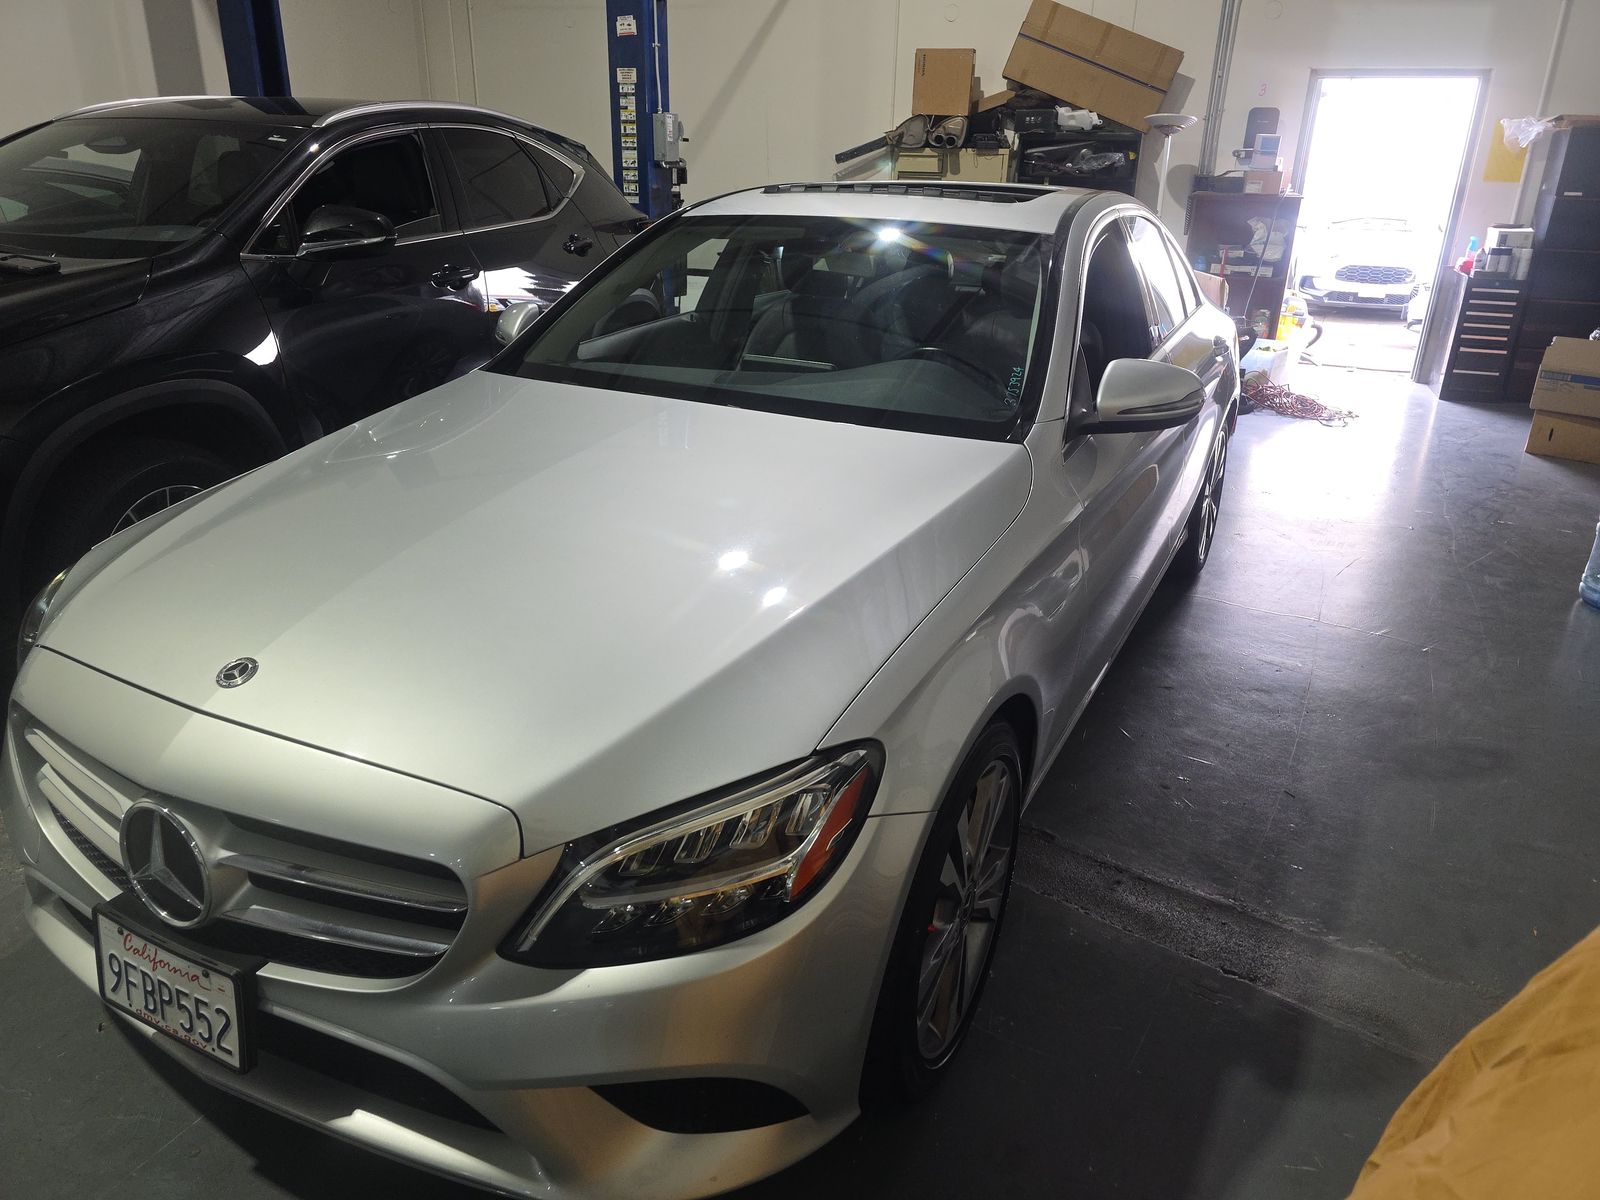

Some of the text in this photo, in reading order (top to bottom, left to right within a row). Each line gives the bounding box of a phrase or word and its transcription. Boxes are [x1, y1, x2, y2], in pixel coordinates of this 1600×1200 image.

[122, 932, 211, 991] California
[108, 952, 233, 1056] 9FBP552
[135, 1007, 208, 1050] dmv.ca.gov
